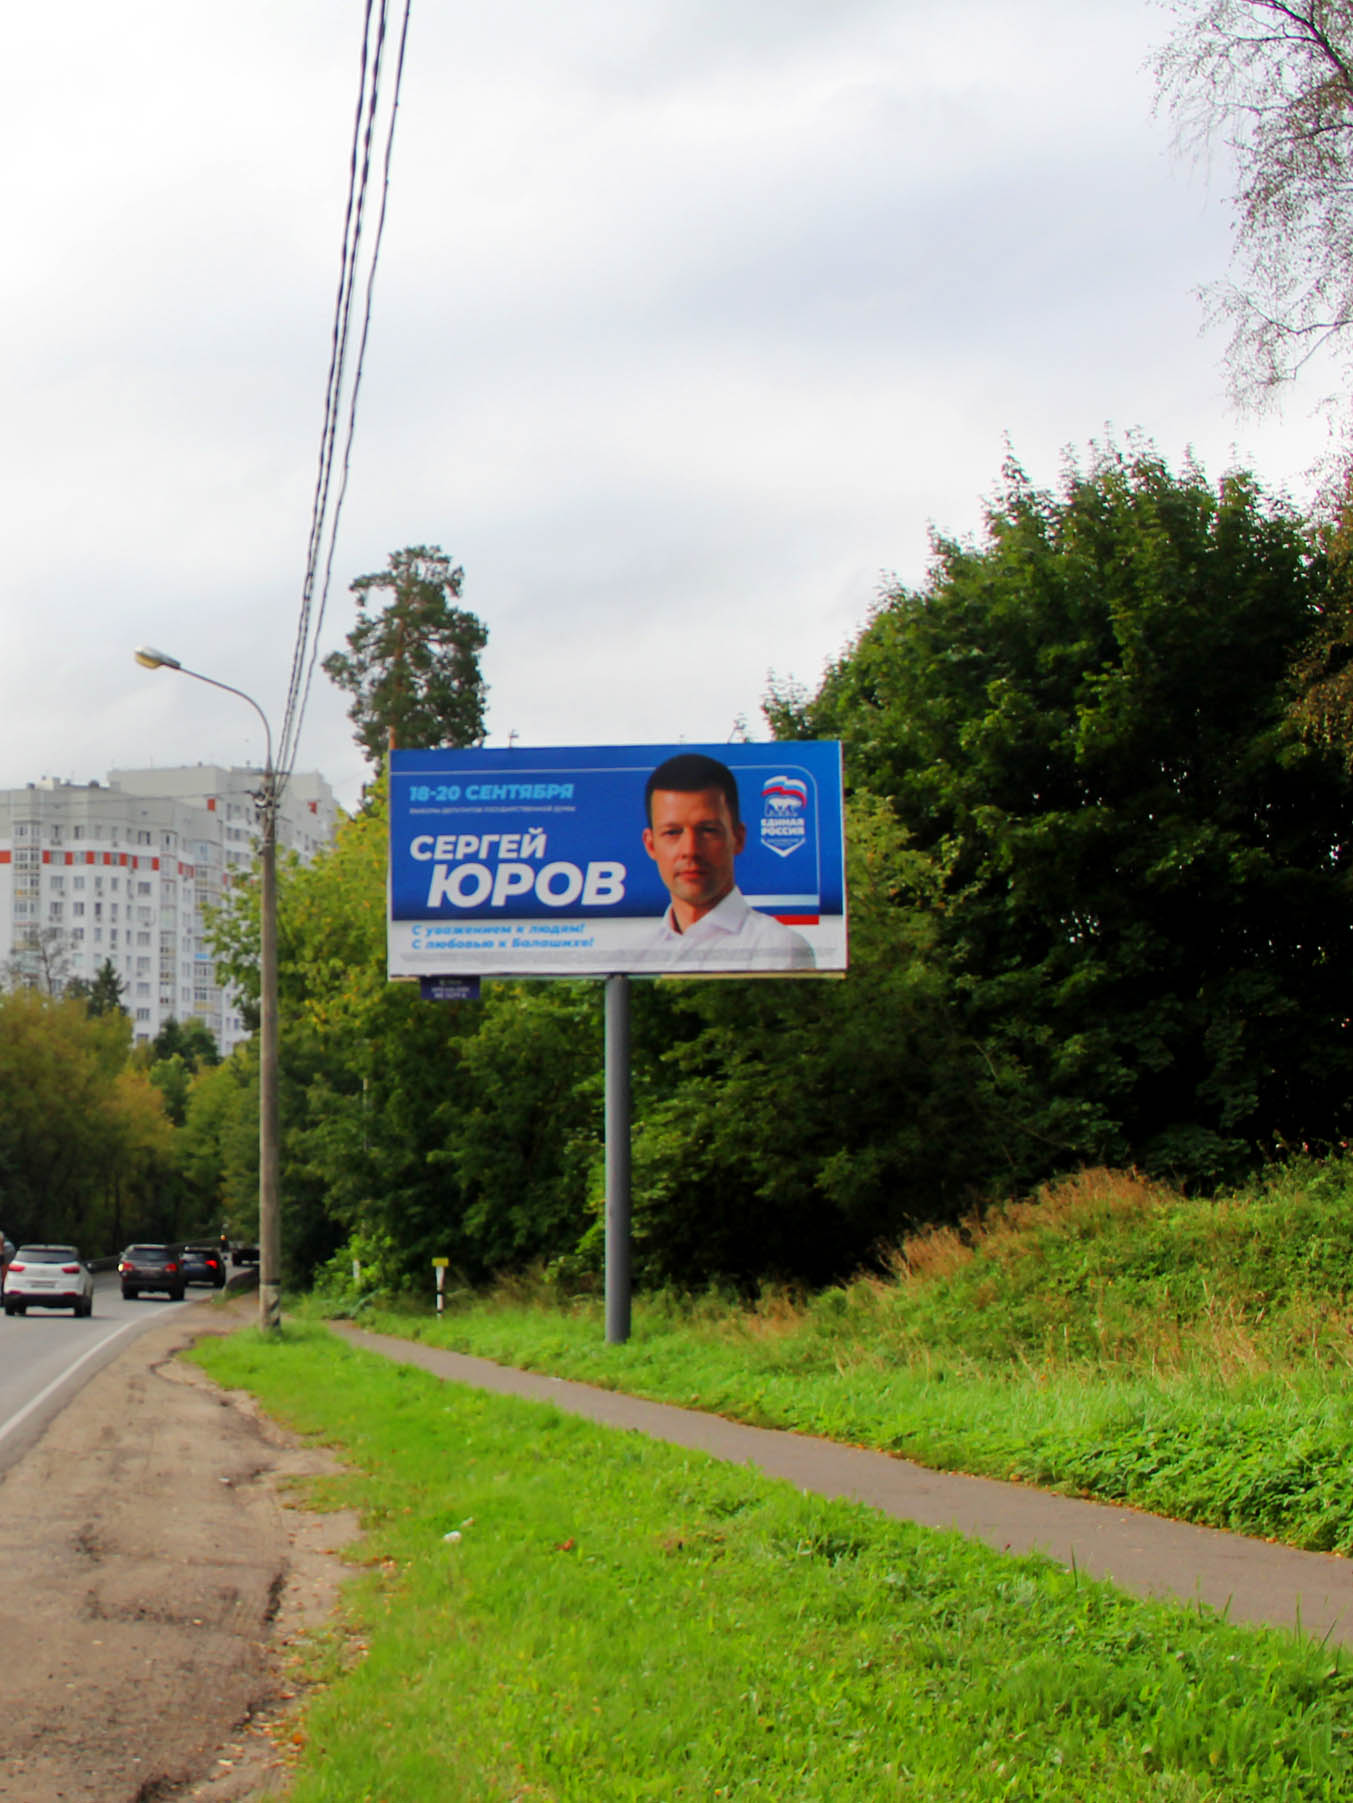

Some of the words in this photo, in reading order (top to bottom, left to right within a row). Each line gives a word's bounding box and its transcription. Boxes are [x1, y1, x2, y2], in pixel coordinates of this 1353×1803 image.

[409, 785, 461, 802] 18-20
[465, 783, 575, 801] СЕНТЯБРЯ
[409, 827, 547, 861] СЕРГЕЙ
[426, 861, 627, 908] ЮРОВ
